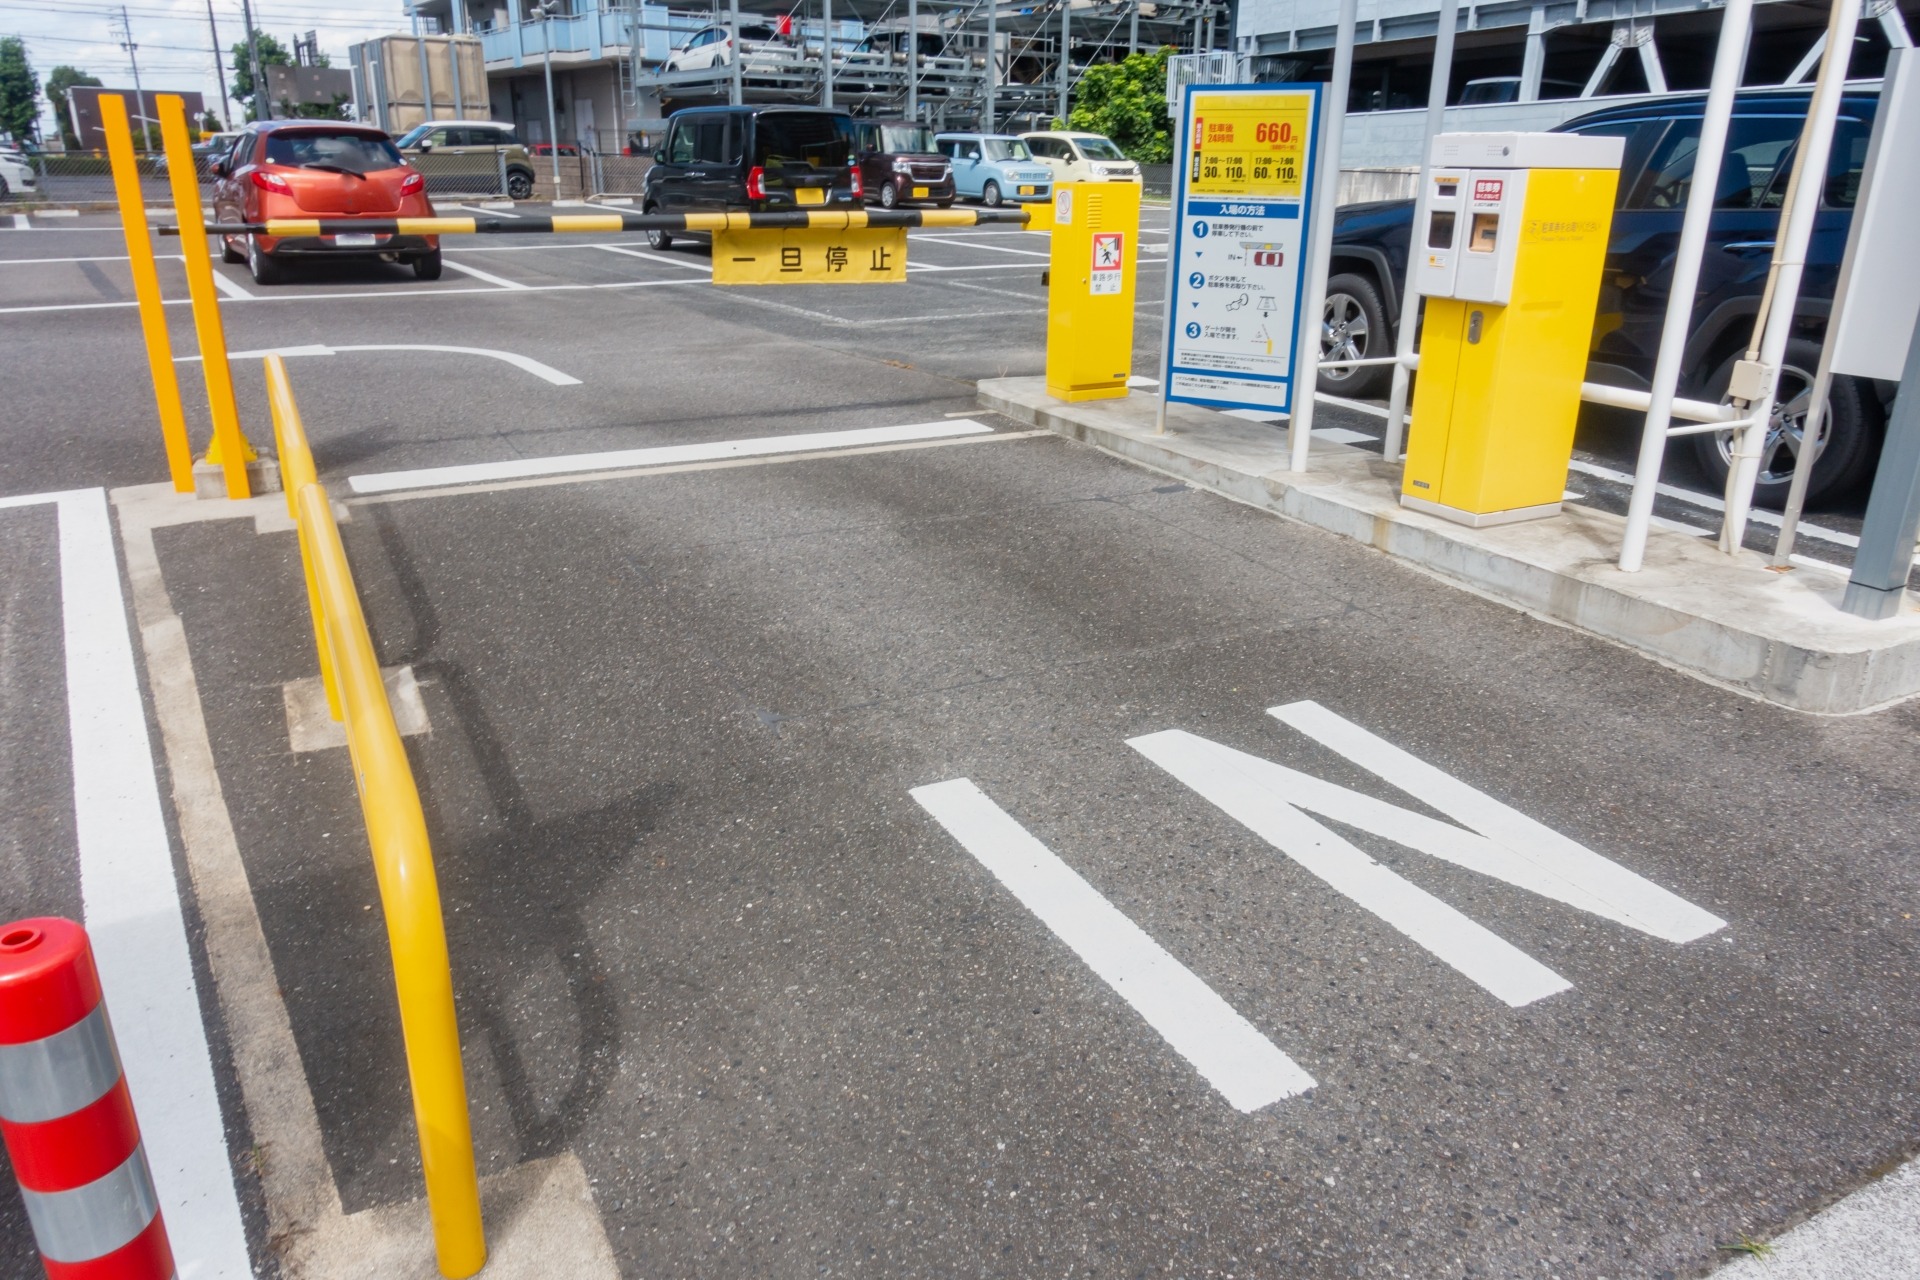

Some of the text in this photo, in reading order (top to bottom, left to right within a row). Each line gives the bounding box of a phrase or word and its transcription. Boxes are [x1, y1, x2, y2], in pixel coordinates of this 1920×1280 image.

[1207, 134, 1234, 143] 24時間
[1256, 122, 1298, 143] 660円
[1476, 182, 1501, 193] 駐車券
[1219, 204, 1265, 215] 入場の方法
[732, 246, 892, 272] 一旦停止
[908, 699, 1728, 1114] IN
